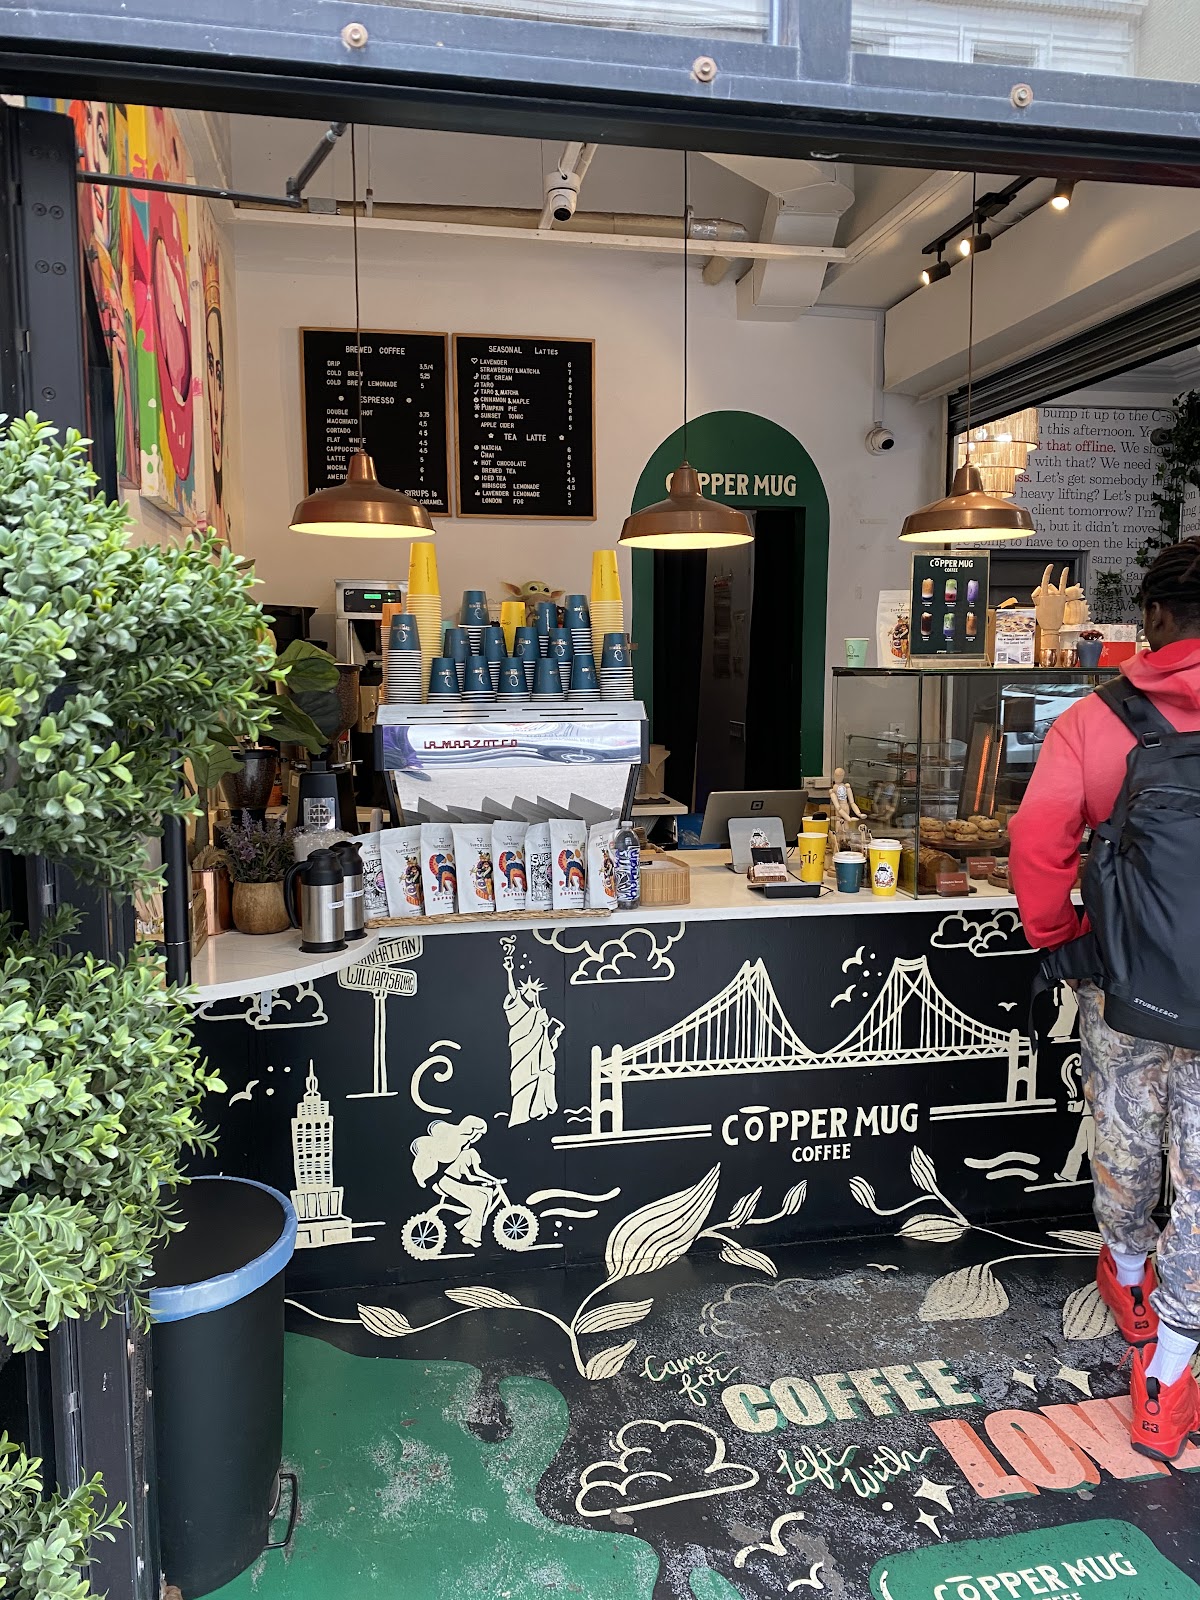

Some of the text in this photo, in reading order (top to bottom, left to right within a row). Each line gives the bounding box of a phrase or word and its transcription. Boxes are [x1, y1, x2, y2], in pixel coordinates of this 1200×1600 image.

[346, 346, 406, 355] BREWED COFFEE
[488, 346, 522, 354] SEASONAL
[360, 396, 394, 404] ESPRESSO
[1043, 408, 1078, 421] bump
[1081, 408, 1090, 419] it
[1094, 411, 1110, 422] up
[1113, 411, 1125, 420] to
[1129, 410, 1148, 421] the
[1048, 423, 1070, 435] this
[1074, 424, 1134, 437] afternoon.
[1047, 439, 1071, 451] that
[1075, 440, 1116, 452] offline.
[1121, 442, 1140, 453] We
[1035, 455, 1061, 467] with
[1066, 456, 1096, 468] that?
[1100, 457, 1120, 469] We
[1124, 459, 1151, 469] need
[665, 472, 797, 496] CPPER MUG
[1036, 471, 1064, 483] Let's
[1068, 474, 1086, 486] get
[1089, 474, 1148, 488] somebody
[1020, 487, 1054, 501] heavy
[1058, 488, 1100, 502] lifting?
[1103, 489, 1131, 501] Let's
[1032, 504, 1064, 516] client
[1068, 506, 1133, 517] tomorrow?
[1137, 506, 1156, 518] I'm
[1050, 520, 1069, 531] but
[1072, 520, 1081, 531] it
[1086, 521, 1120, 532] didn't
[1123, 525, 1155, 533] move
[1010, 538, 1022, 546] to
[1026, 536, 1053, 547] have
[1057, 538, 1068, 547] to
[1072, 539, 1100, 550] open
[1104, 537, 1123, 548] the
[930, 558, 958, 568] COPPER
[1092, 555, 1122, 564] same
[357, 938, 416, 966] NHATTAN
[347, 966, 414, 991] WILLIAMSBURG
[722, 1103, 918, 1146] COPPER MUG
[792, 1143, 851, 1163] COFFEE
[1134, 1320, 1150, 1329] 23
[640, 1351, 727, 1382] Came
[679, 1366, 741, 1407] for
[722, 1359, 980, 1434] COFFEE
[1142, 1420, 1160, 1434] 23
[928, 1395, 1200, 1501] LOV
[776, 1444, 861, 1495] Left
[842, 1445, 938, 1498] With
[1061, 1552, 1138, 1586] MUG
